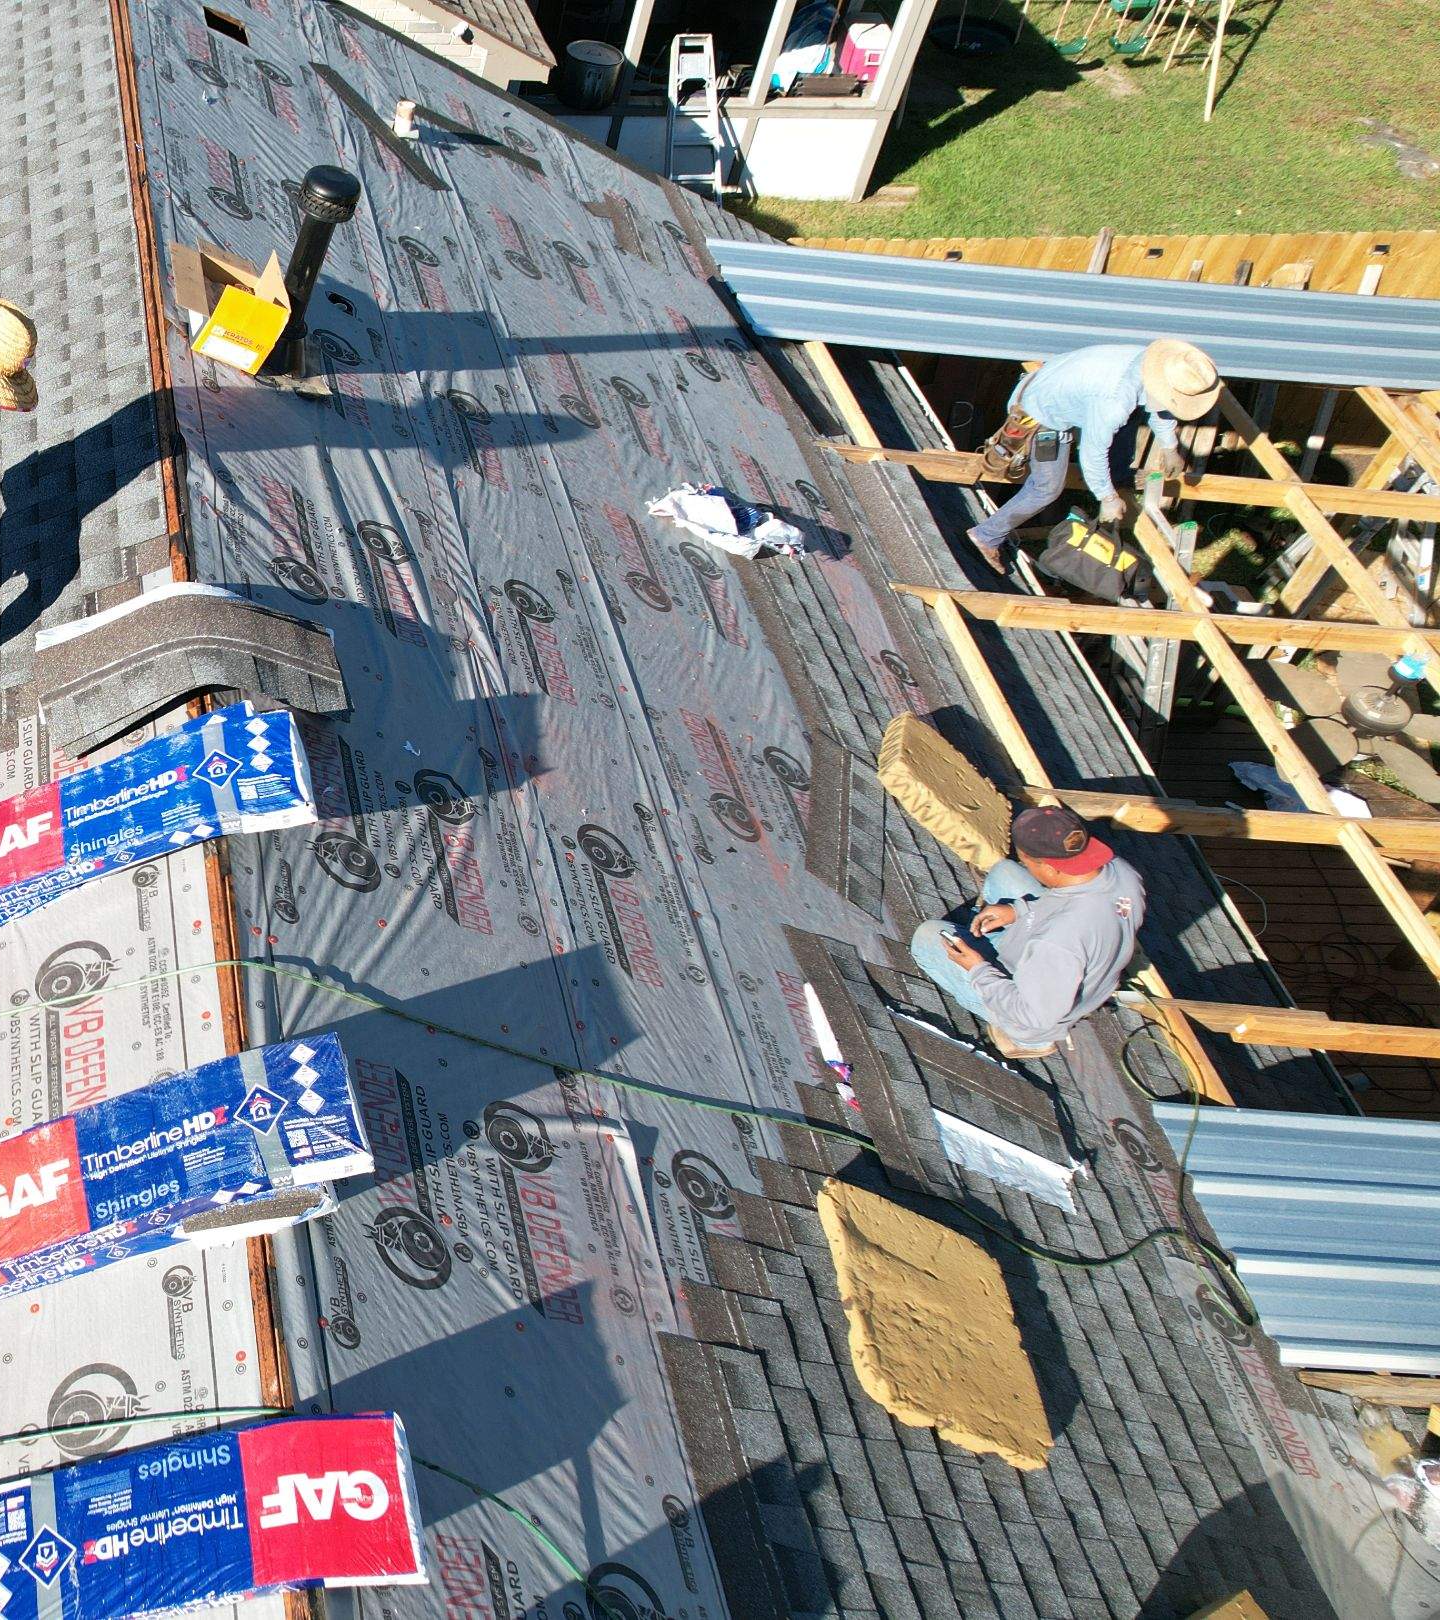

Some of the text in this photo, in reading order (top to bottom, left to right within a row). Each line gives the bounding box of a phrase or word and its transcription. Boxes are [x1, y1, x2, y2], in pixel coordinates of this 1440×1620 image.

[23, 723, 34, 790] SLIP GUARD
[64, 780, 151, 821] Timberline
[353, 750, 382, 848] WITH SLIP GUARD
[70, 824, 144, 860] Shingles
[413, 807, 429, 843] WITH
[420, 842, 434, 869] SLIP
[425, 867, 443, 911] GUARD
[579, 862, 597, 897] WITH
[589, 896, 605, 924] SLIP
[596, 923, 616, 965] GUARD
[29, 1012, 42, 1122] WITH SLIP GUA
[61, 996, 108, 1110] VB DEFEN
[414, 1083, 434, 1140] GUARD
[83, 1124, 182, 1172] Timberline
[424, 1140, 440, 1177] SLIP
[436, 1110, 469, 1237] VBSYNTHETICS.COM
[517, 1172, 559, 1211] VB
[96, 1178, 180, 1219] Shingles
[465, 1142, 499, 1274] VBSYNTHETICS.COM
[484, 1157, 523, 1303] WITH SLIP GUARD
[676, 1204, 705, 1284] WITH SLIP
[6, 1234, 98, 1275] Timberline
[181, 1292, 194, 1314] VB
[330, 1296, 340, 1318] VB
[334, 1256, 349, 1315] SYNTHETICS
[173, 1300, 186, 1361] SYNTHETICS
[181, 1369, 192, 1397] ASTM
[138, 1444, 231, 1480] Shingles
[260, 1470, 390, 1529] GAF
[129, 1505, 244, 1549] Timberline
